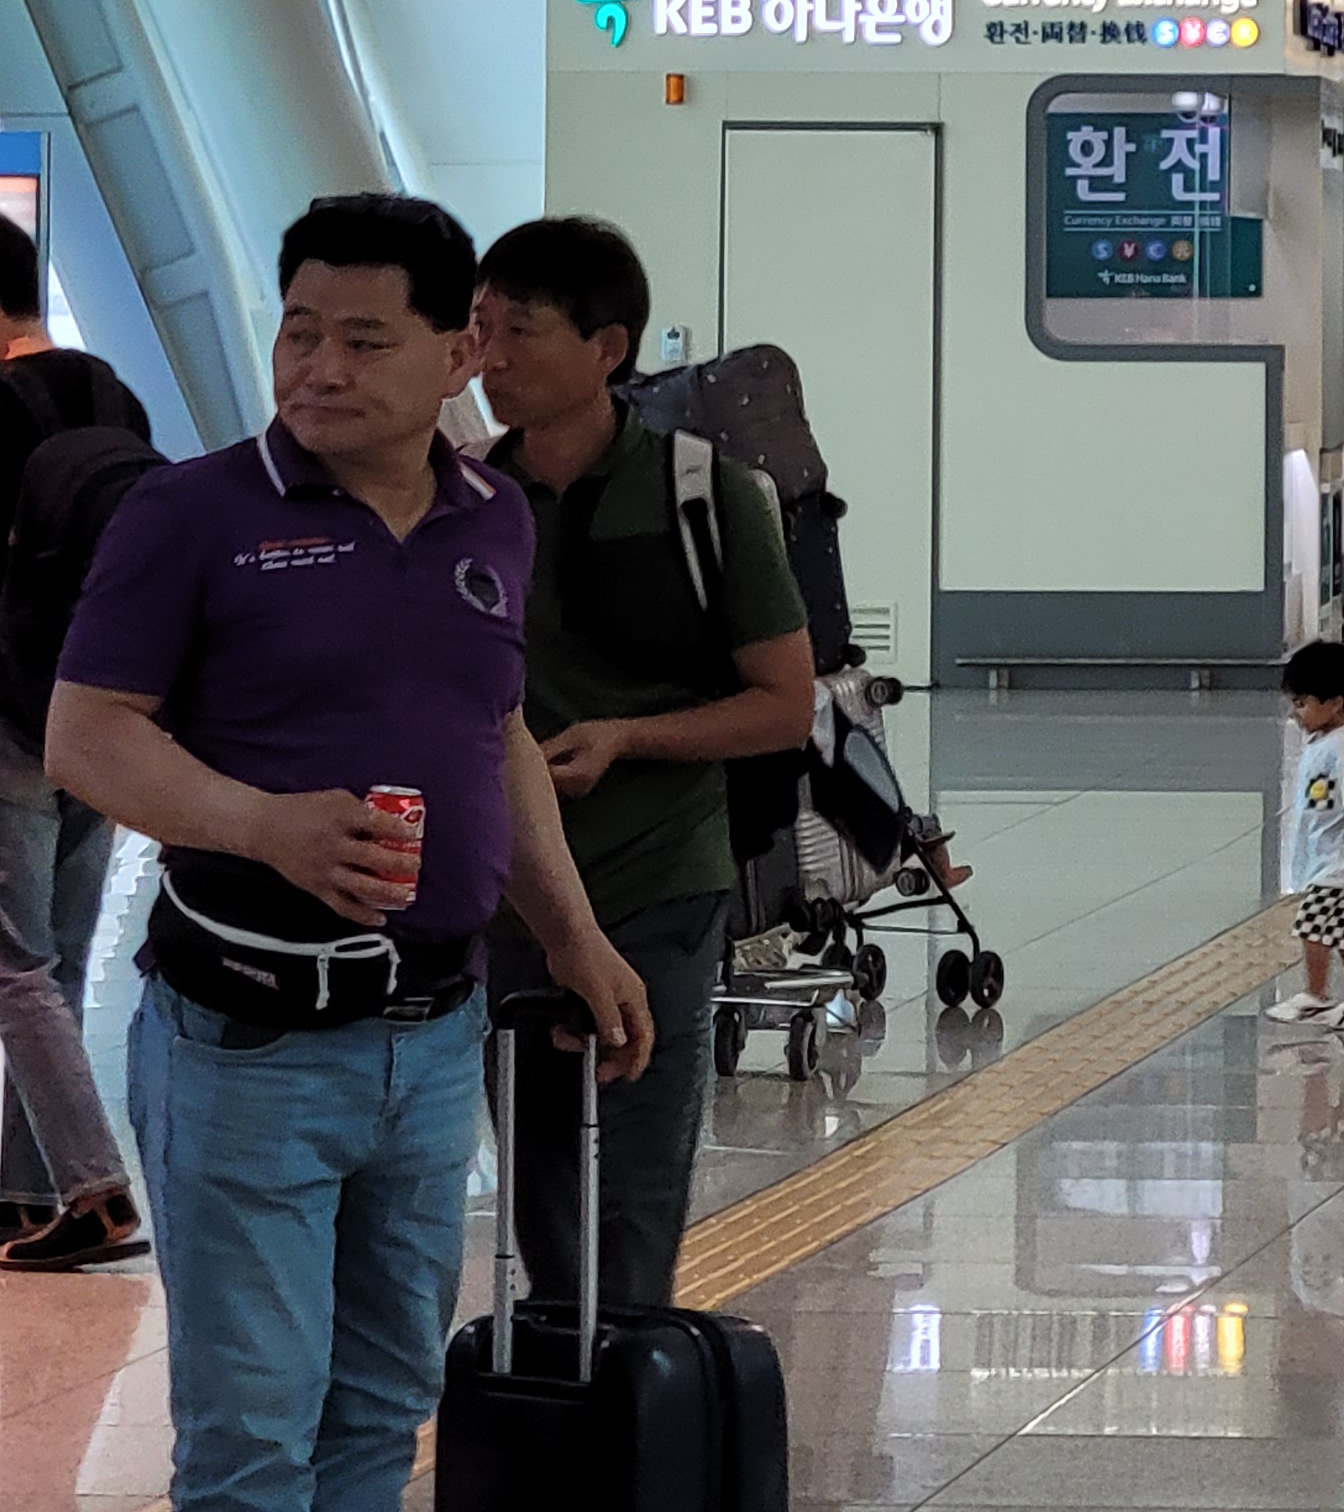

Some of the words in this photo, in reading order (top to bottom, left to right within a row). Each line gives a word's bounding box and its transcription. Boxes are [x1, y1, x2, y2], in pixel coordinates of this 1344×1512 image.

[1064, 125, 1222, 202] 환전
[1063, 215, 1113, 228] Currency
[1114, 215, 1167, 228] Exchange
